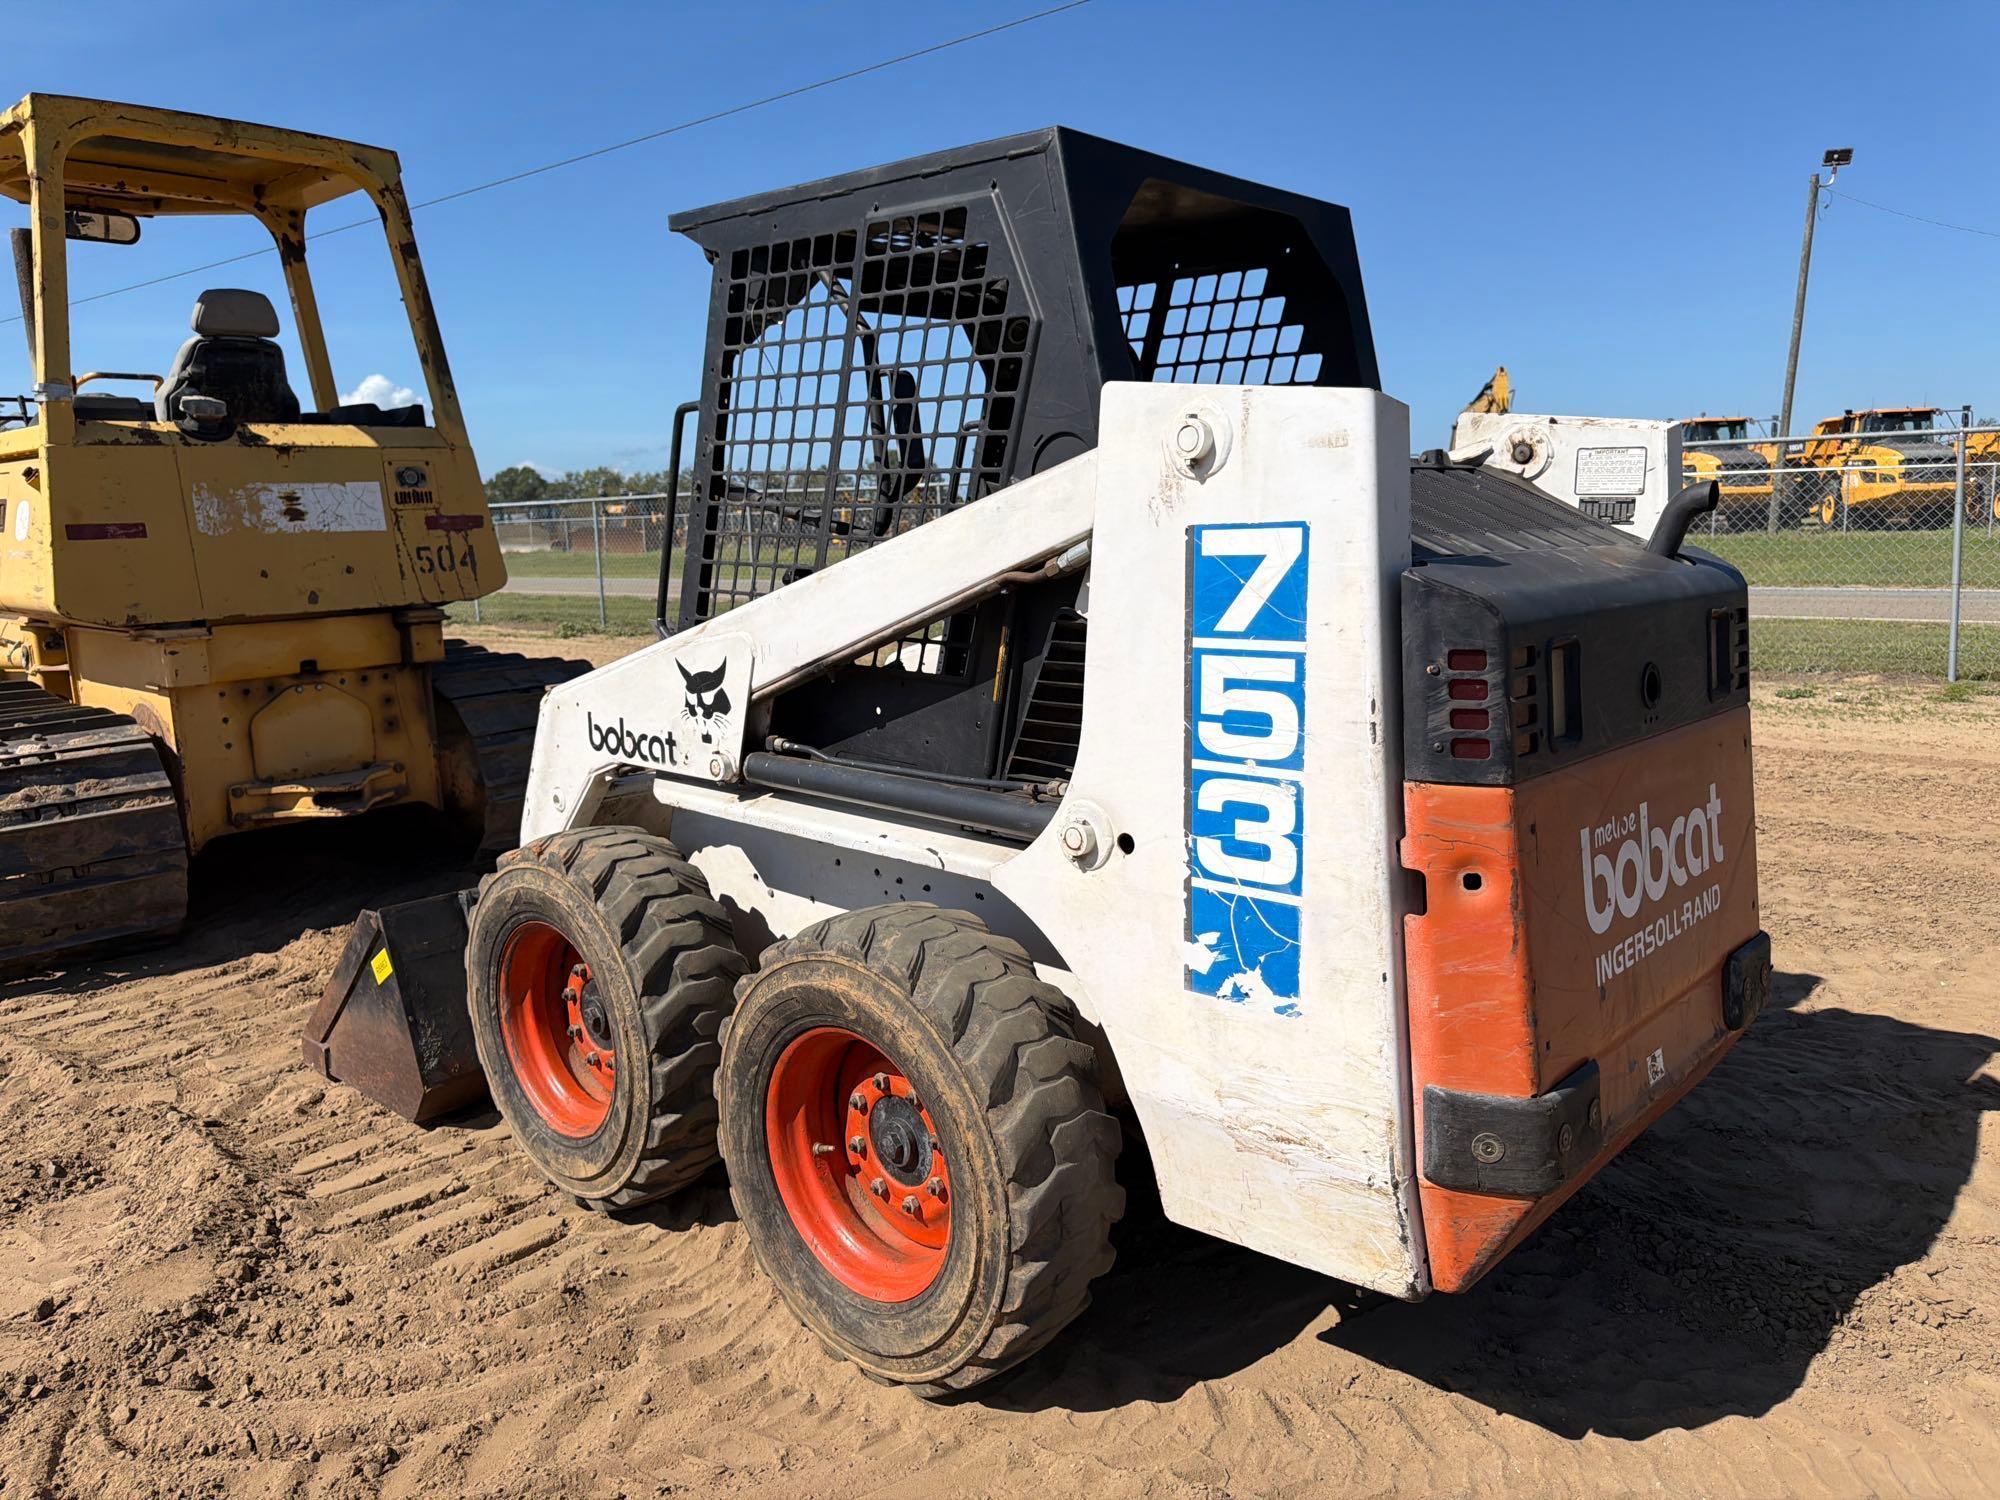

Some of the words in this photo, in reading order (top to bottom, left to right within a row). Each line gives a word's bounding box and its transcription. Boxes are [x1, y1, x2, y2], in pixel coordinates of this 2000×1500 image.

[415, 545, 478, 574] 504
[587, 711, 677, 766] bobcat
[1197, 527, 1303, 885] 753
[1580, 782, 1724, 934] bobcat
